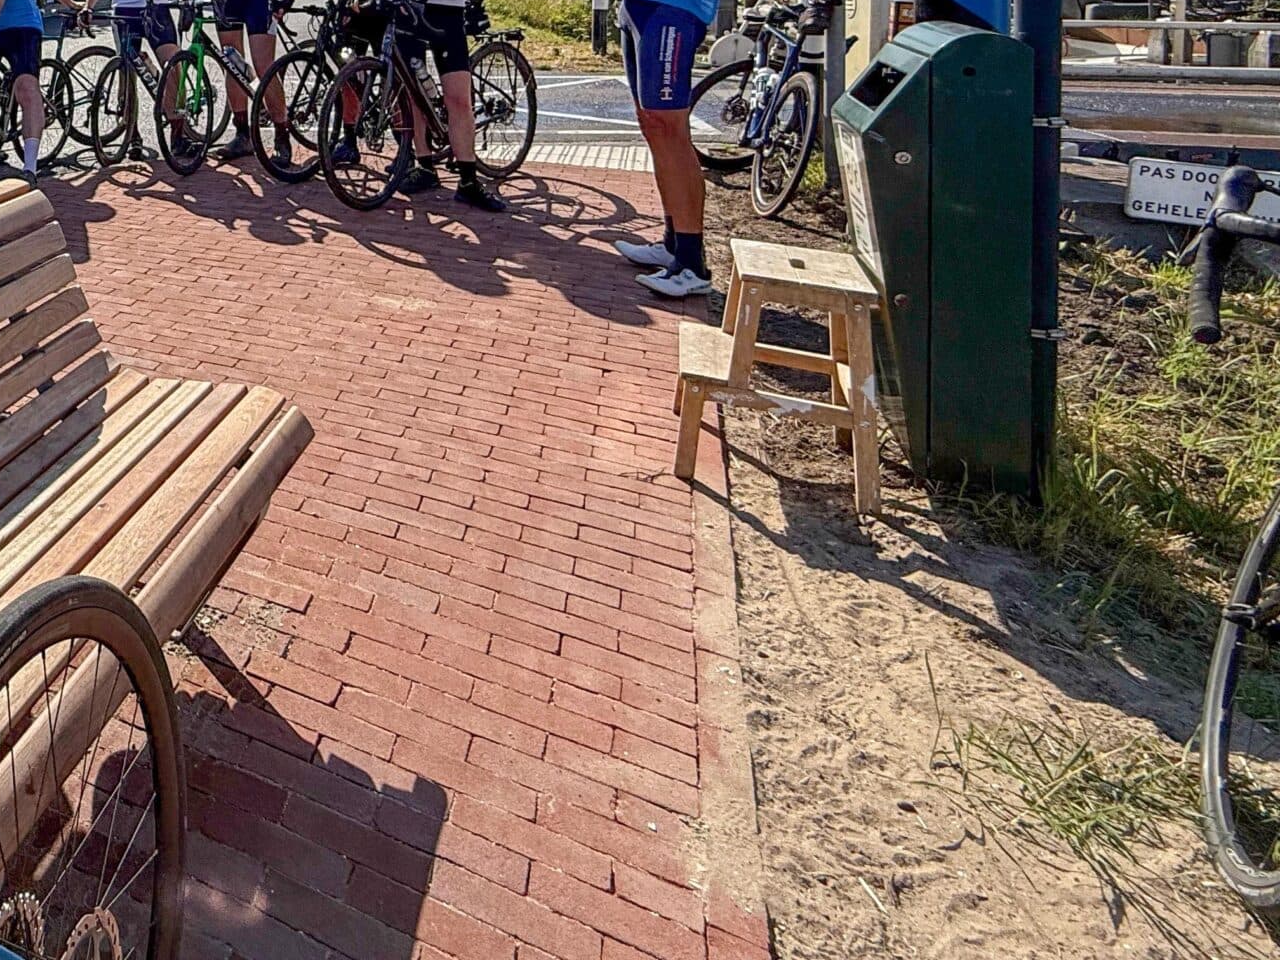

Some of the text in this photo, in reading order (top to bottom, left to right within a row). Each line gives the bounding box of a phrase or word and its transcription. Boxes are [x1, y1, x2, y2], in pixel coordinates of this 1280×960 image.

[132, 56, 158, 96] FACT
[1139, 165, 1219, 185] PAS DOO
[1132, 199, 1206, 220] GEHELE
